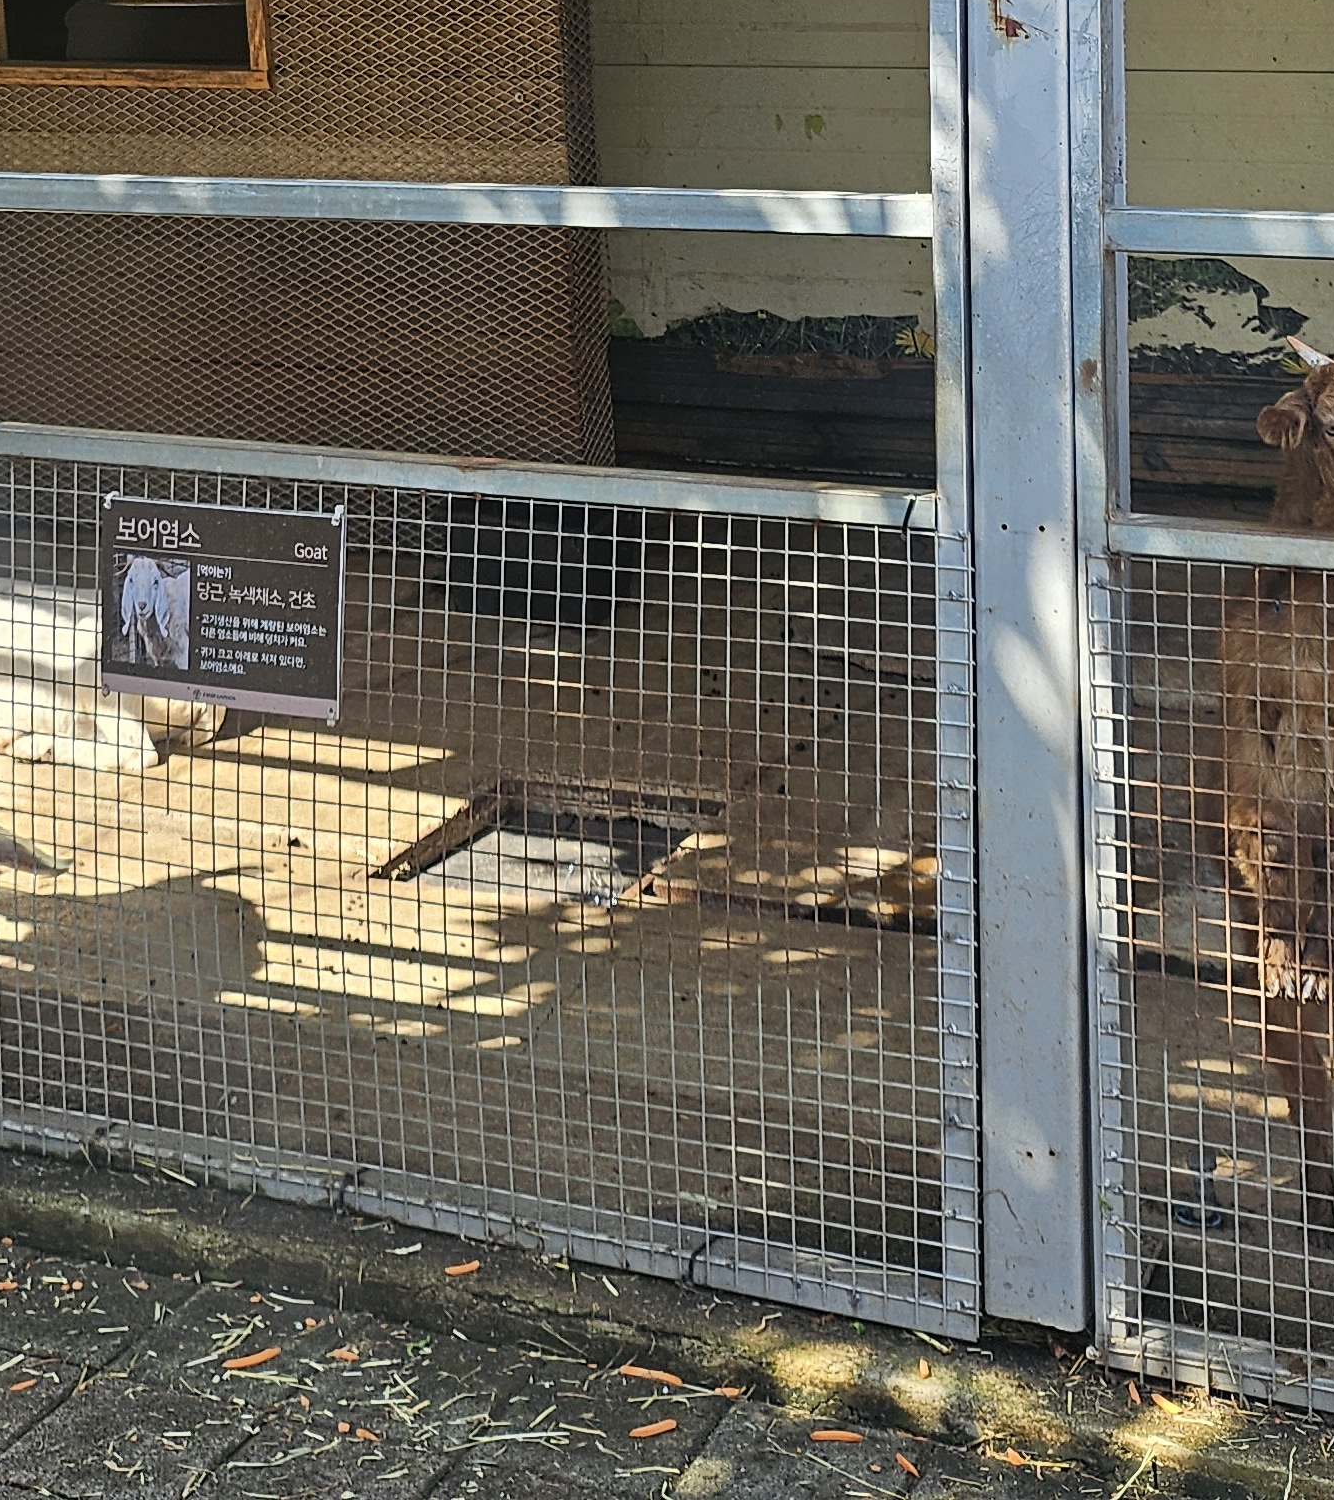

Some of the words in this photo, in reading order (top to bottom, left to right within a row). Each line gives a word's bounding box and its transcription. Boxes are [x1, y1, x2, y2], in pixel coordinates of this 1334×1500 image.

[116, 516, 201, 549] 보어염소
[294, 543, 328, 560] Goat
[197, 581, 227, 603] 당근,
[229, 584, 286, 609] 녹색채소,
[288, 590, 317, 610] 건초
